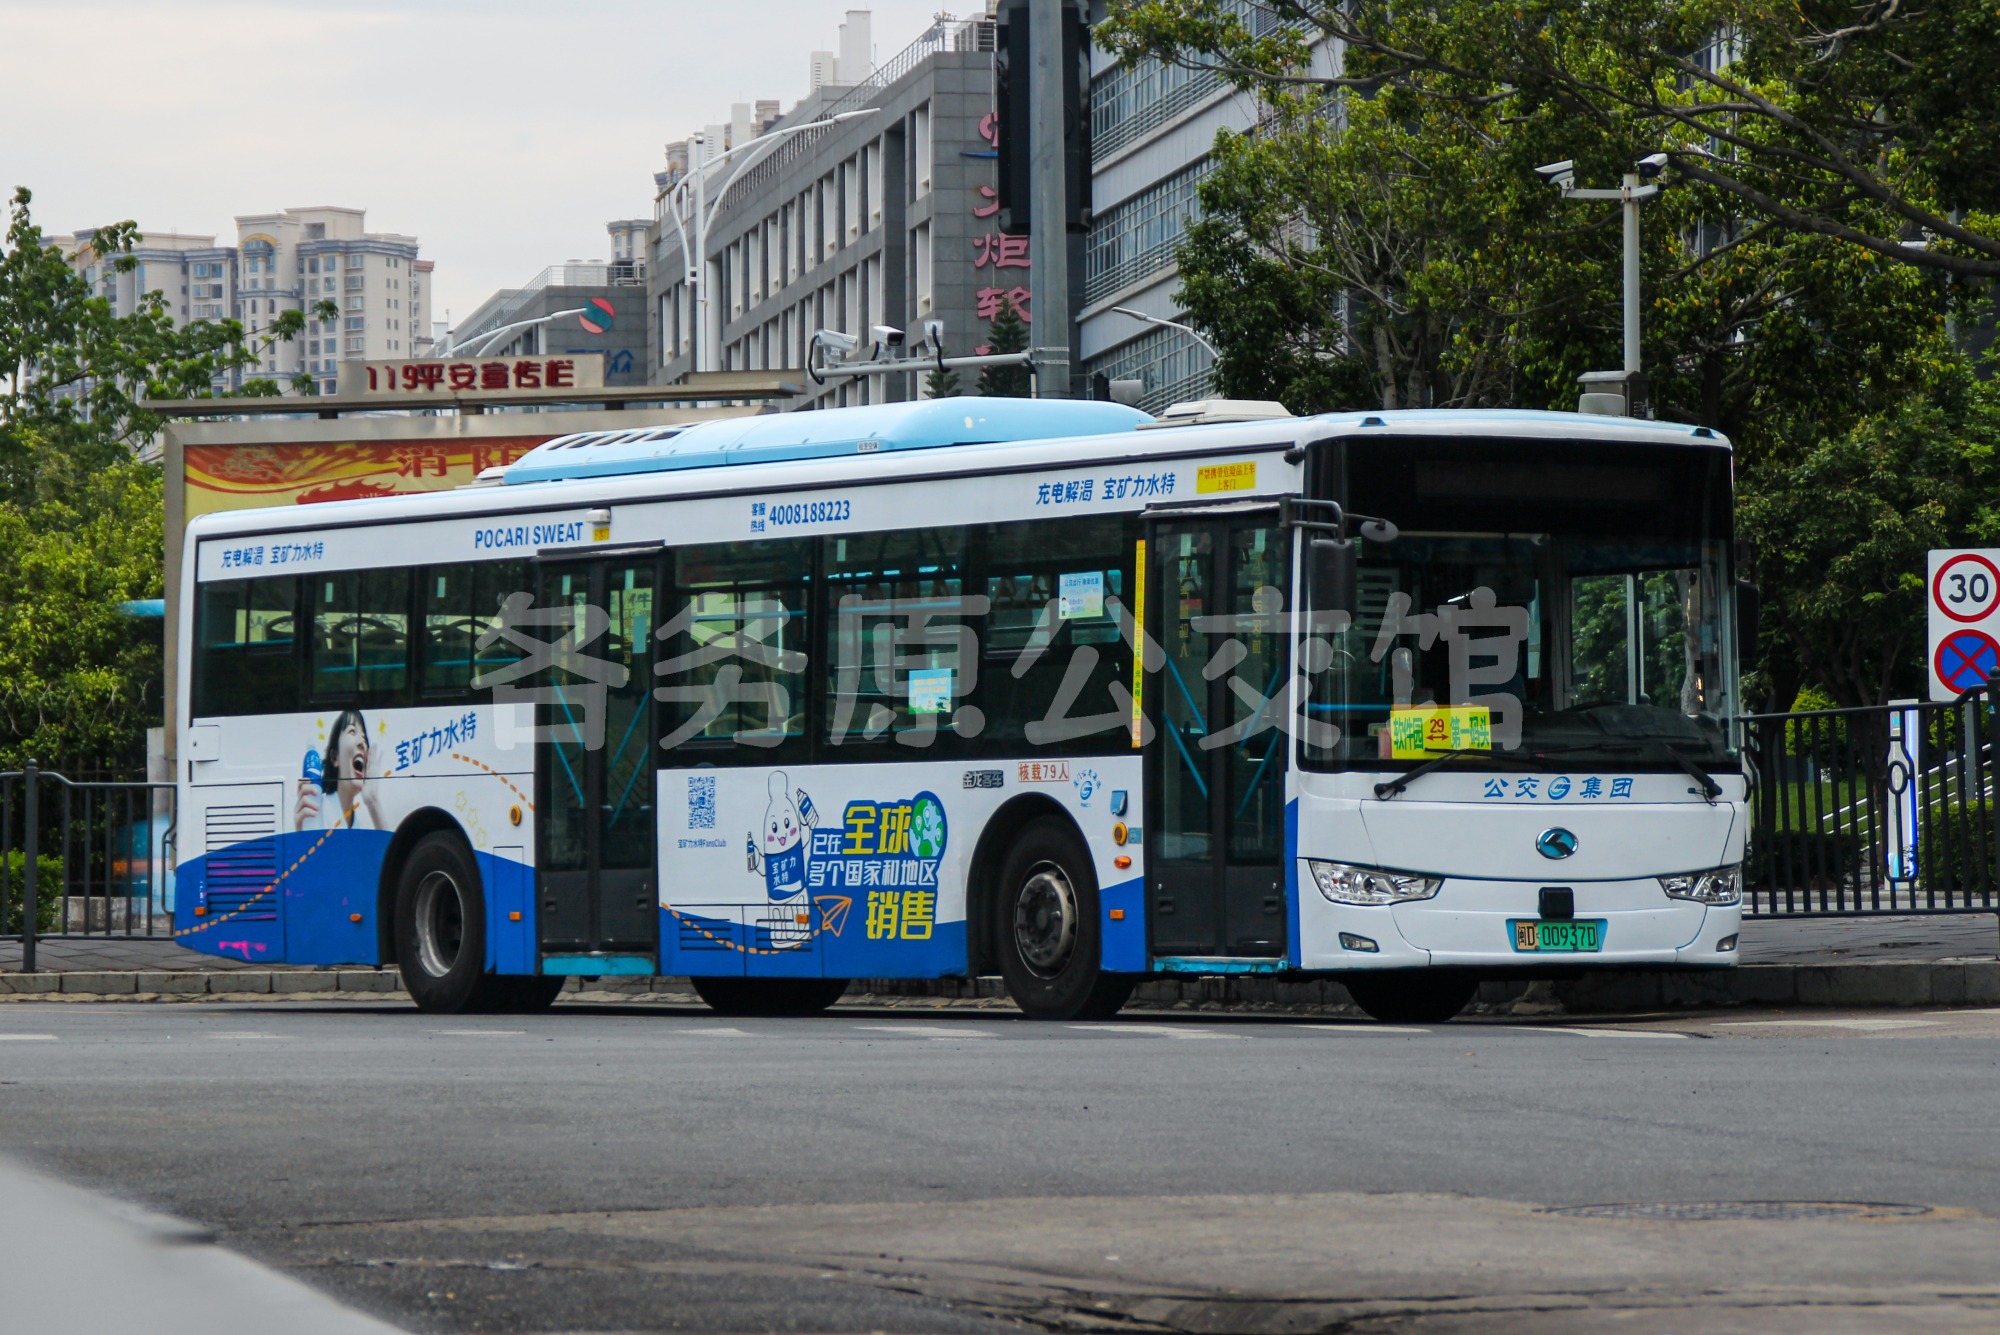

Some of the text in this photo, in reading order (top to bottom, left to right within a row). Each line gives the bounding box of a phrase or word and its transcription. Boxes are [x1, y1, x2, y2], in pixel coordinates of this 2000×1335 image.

[366, 360, 574, 390] 119平安宣传栏
[1036, 471, 1176, 506] 充电解渴 宝矿力水特
[751, 502, 766, 516] 客服
[769, 500, 850, 525] 4008188223
[475, 526, 529, 549] POCARI
[532, 522, 584, 545] SWEAT
[750, 518, 765, 532] 热线
[221, 541, 324, 568] 充电解渴 宝矿力水特
[1948, 573, 1989, 603] 30
[394, 711, 477, 771] 宝矿力水特
[1393, 715, 1490, 751] 软件园 29 第一码头
[963, 770, 1004, 789] 金龙客车
[1019, 762, 1069, 781] 核载79人
[772, 856, 796, 874] 宝矿力
[773, 871, 789, 886] 水特
[808, 859, 939, 887] 多个国家和地区
[865, 890, 936, 940] 销售
